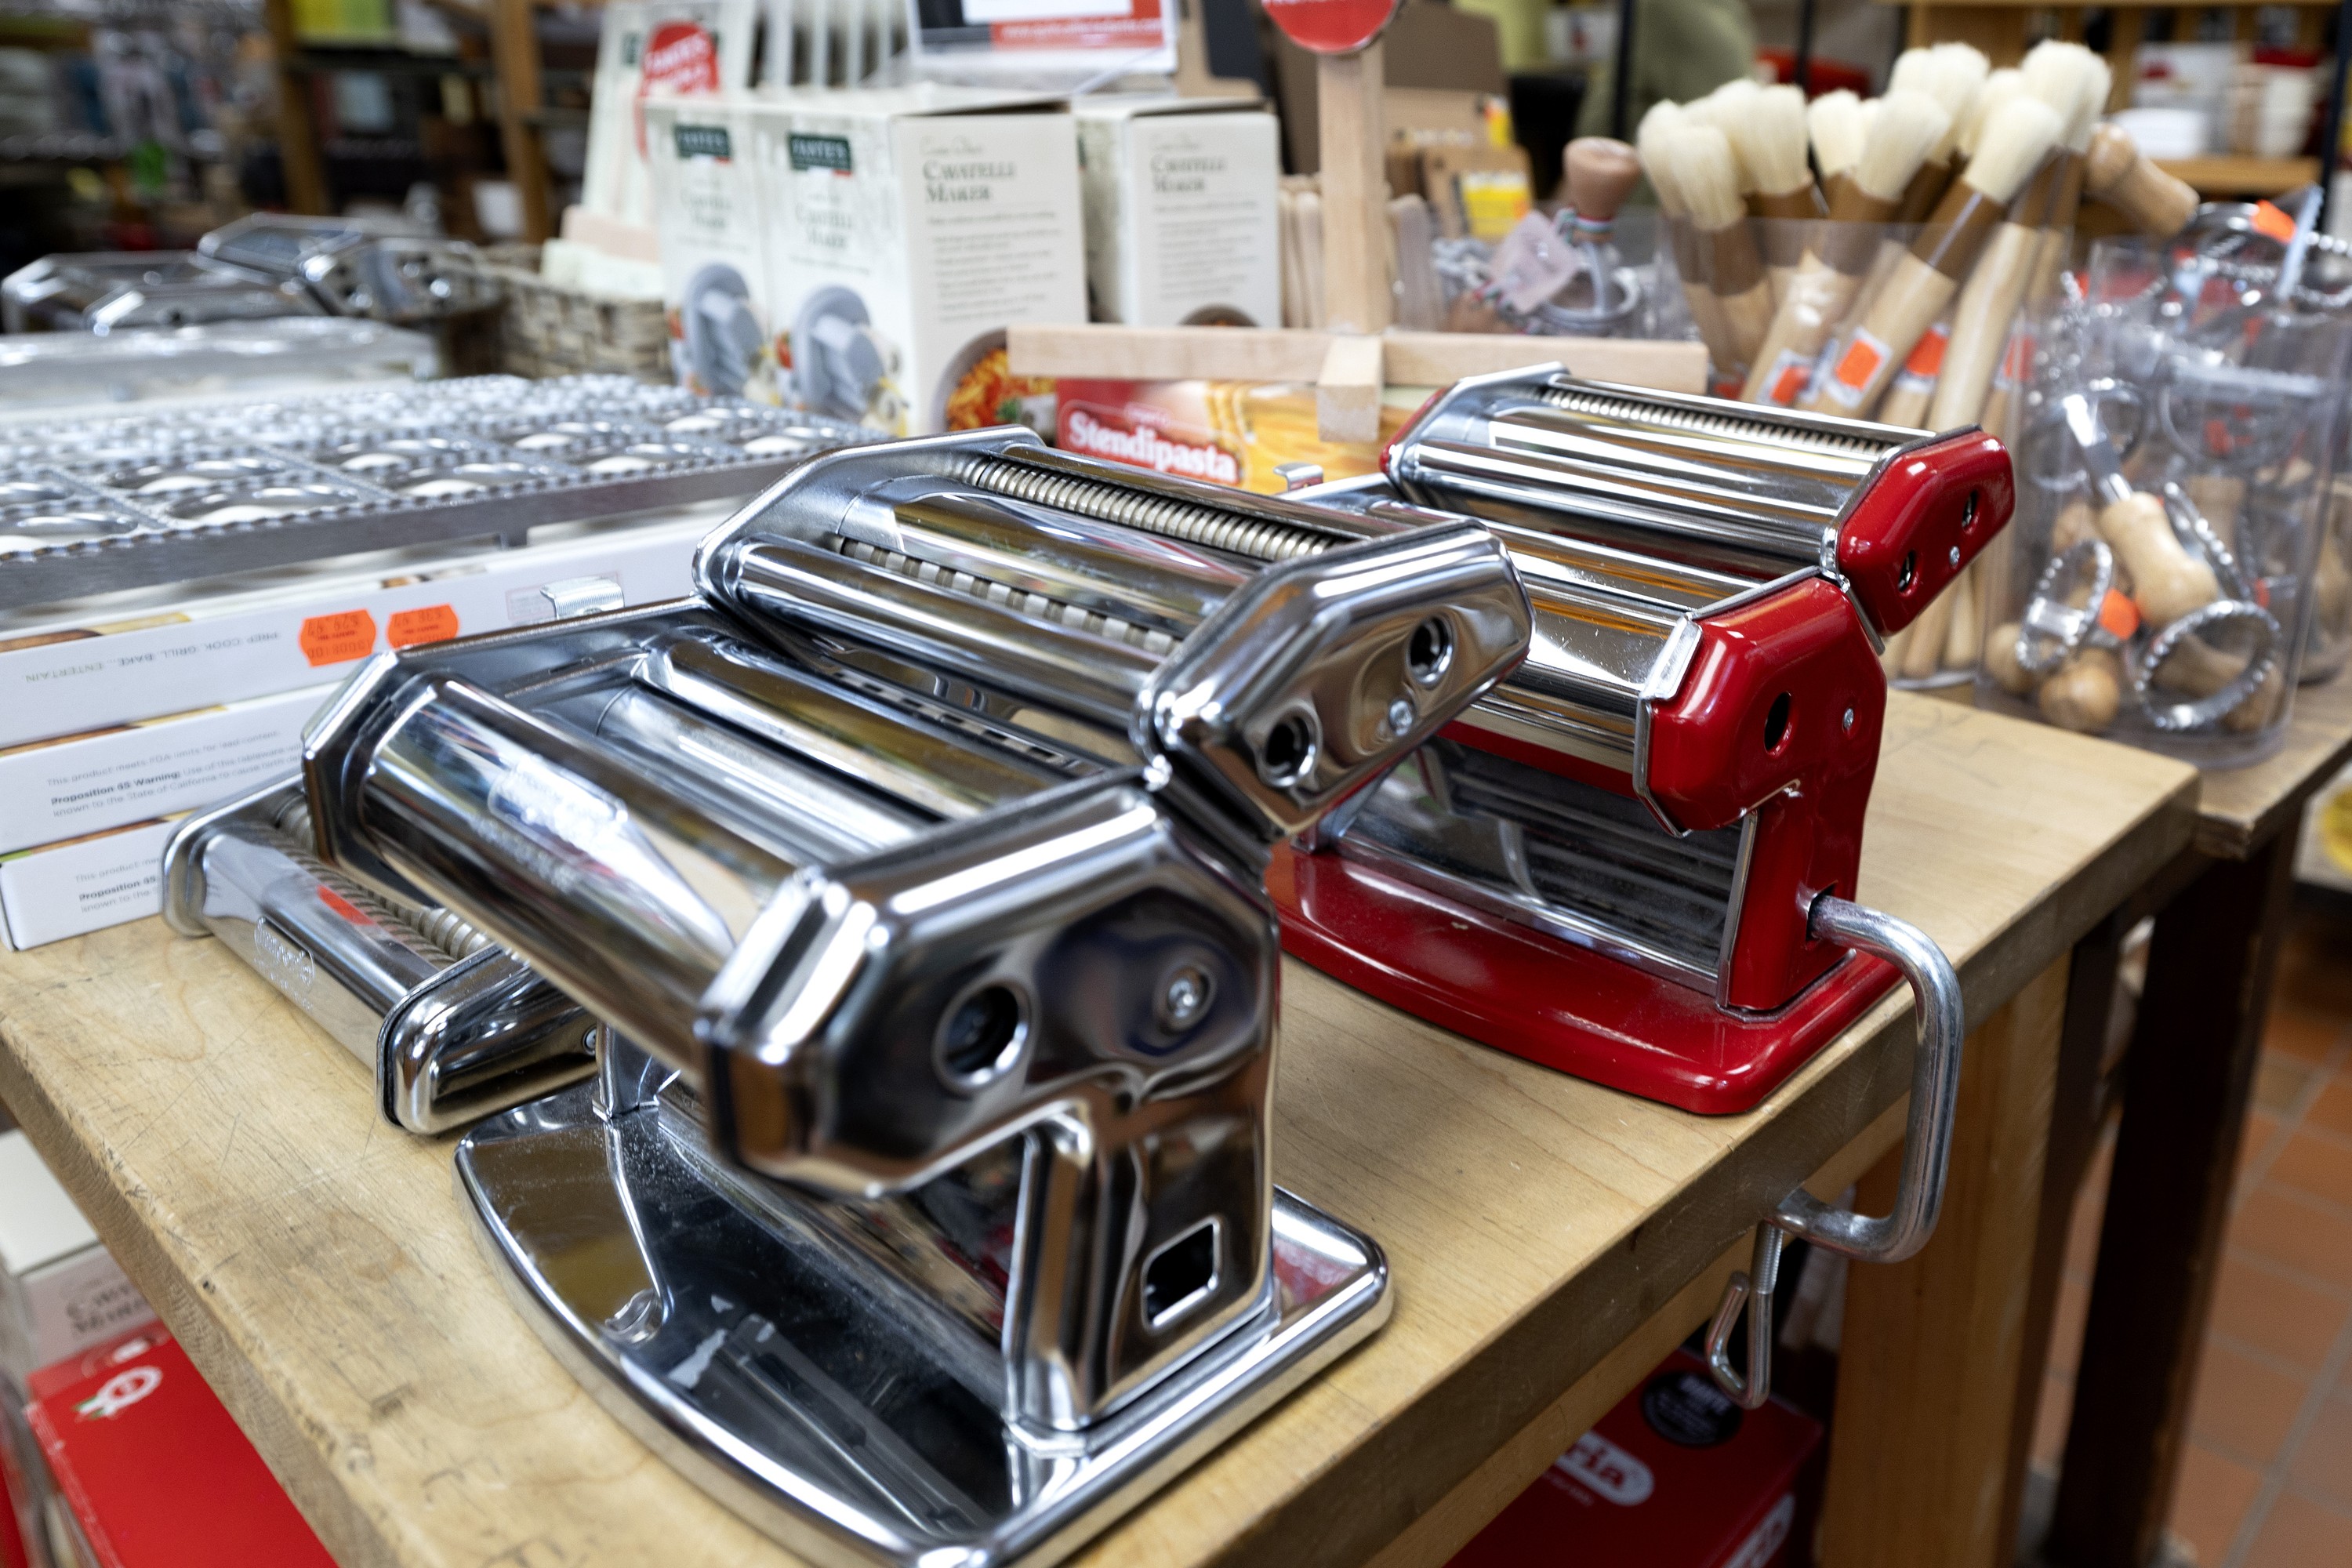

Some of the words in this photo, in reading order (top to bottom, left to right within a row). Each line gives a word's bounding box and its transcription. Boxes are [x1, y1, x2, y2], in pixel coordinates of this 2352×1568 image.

[1069, 410, 1238, 484] Stendipasta
[47, 777, 68, 787] This
[71, 766, 112, 782] product
[115, 760, 146, 771] meets
[149, 754, 171, 765] FDA
[174, 748, 200, 759] limits
[203, 743, 216, 752] for
[51, 786, 114, 807] Proposition
[118, 781, 131, 791] 65
[133, 770, 180, 786] Warning:
[183, 766, 201, 776] Use
[205, 761, 216, 771] of
[216, 758, 235, 768] this
[238, 747, 285, 762] tableware
[53, 804, 89, 818] known
[92, 800, 103, 808] to
[107, 795, 124, 804] the
[126, 788, 154, 800] State
[169, 773, 217, 790] California
[220, 770, 230, 779] to
[76, 873, 96, 883] This
[99, 862, 140, 878] product
[79, 880, 140, 902] Proposition
[81, 899, 117, 913] known
[119, 895, 130, 903] to
[133, 889, 151, 899] the
